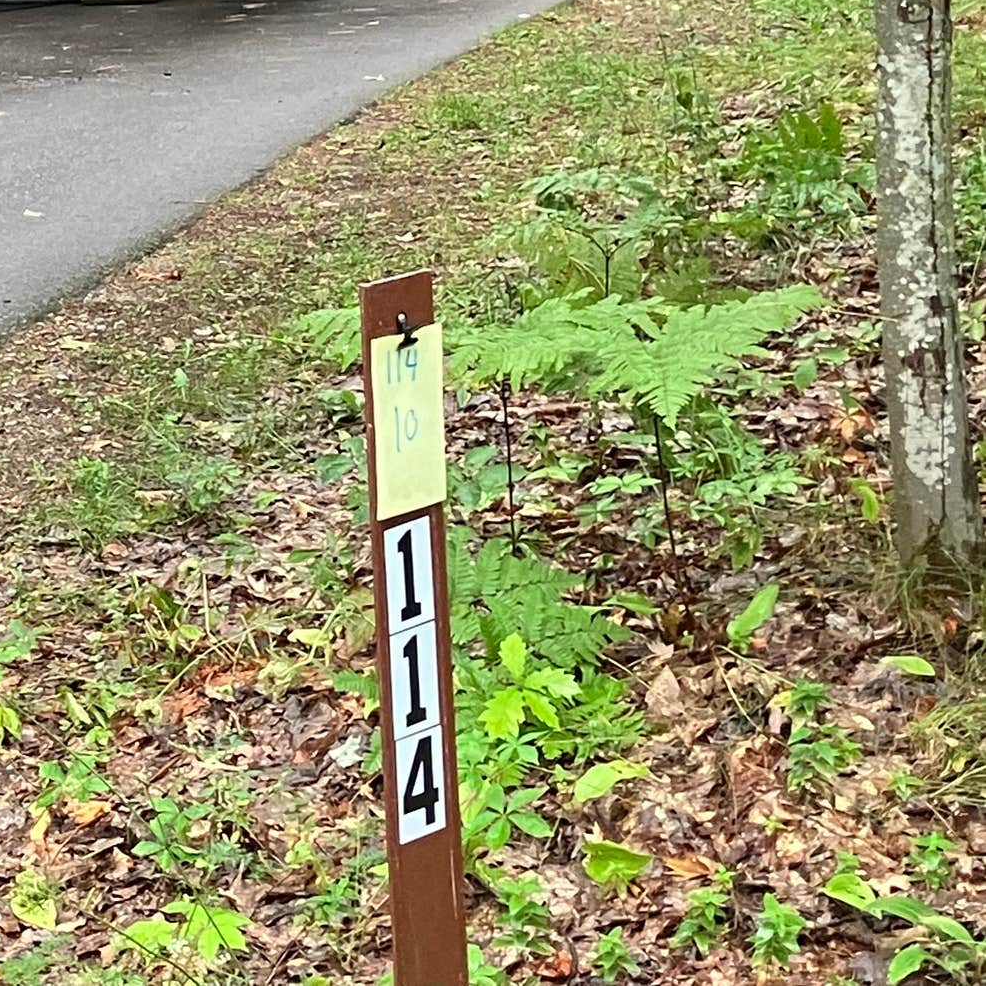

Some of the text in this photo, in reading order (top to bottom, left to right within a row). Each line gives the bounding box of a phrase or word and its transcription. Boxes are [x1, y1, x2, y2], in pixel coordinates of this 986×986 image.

[387, 348, 417, 384] 114
[394, 406, 418, 452] 10
[397, 529, 439, 826] 114
